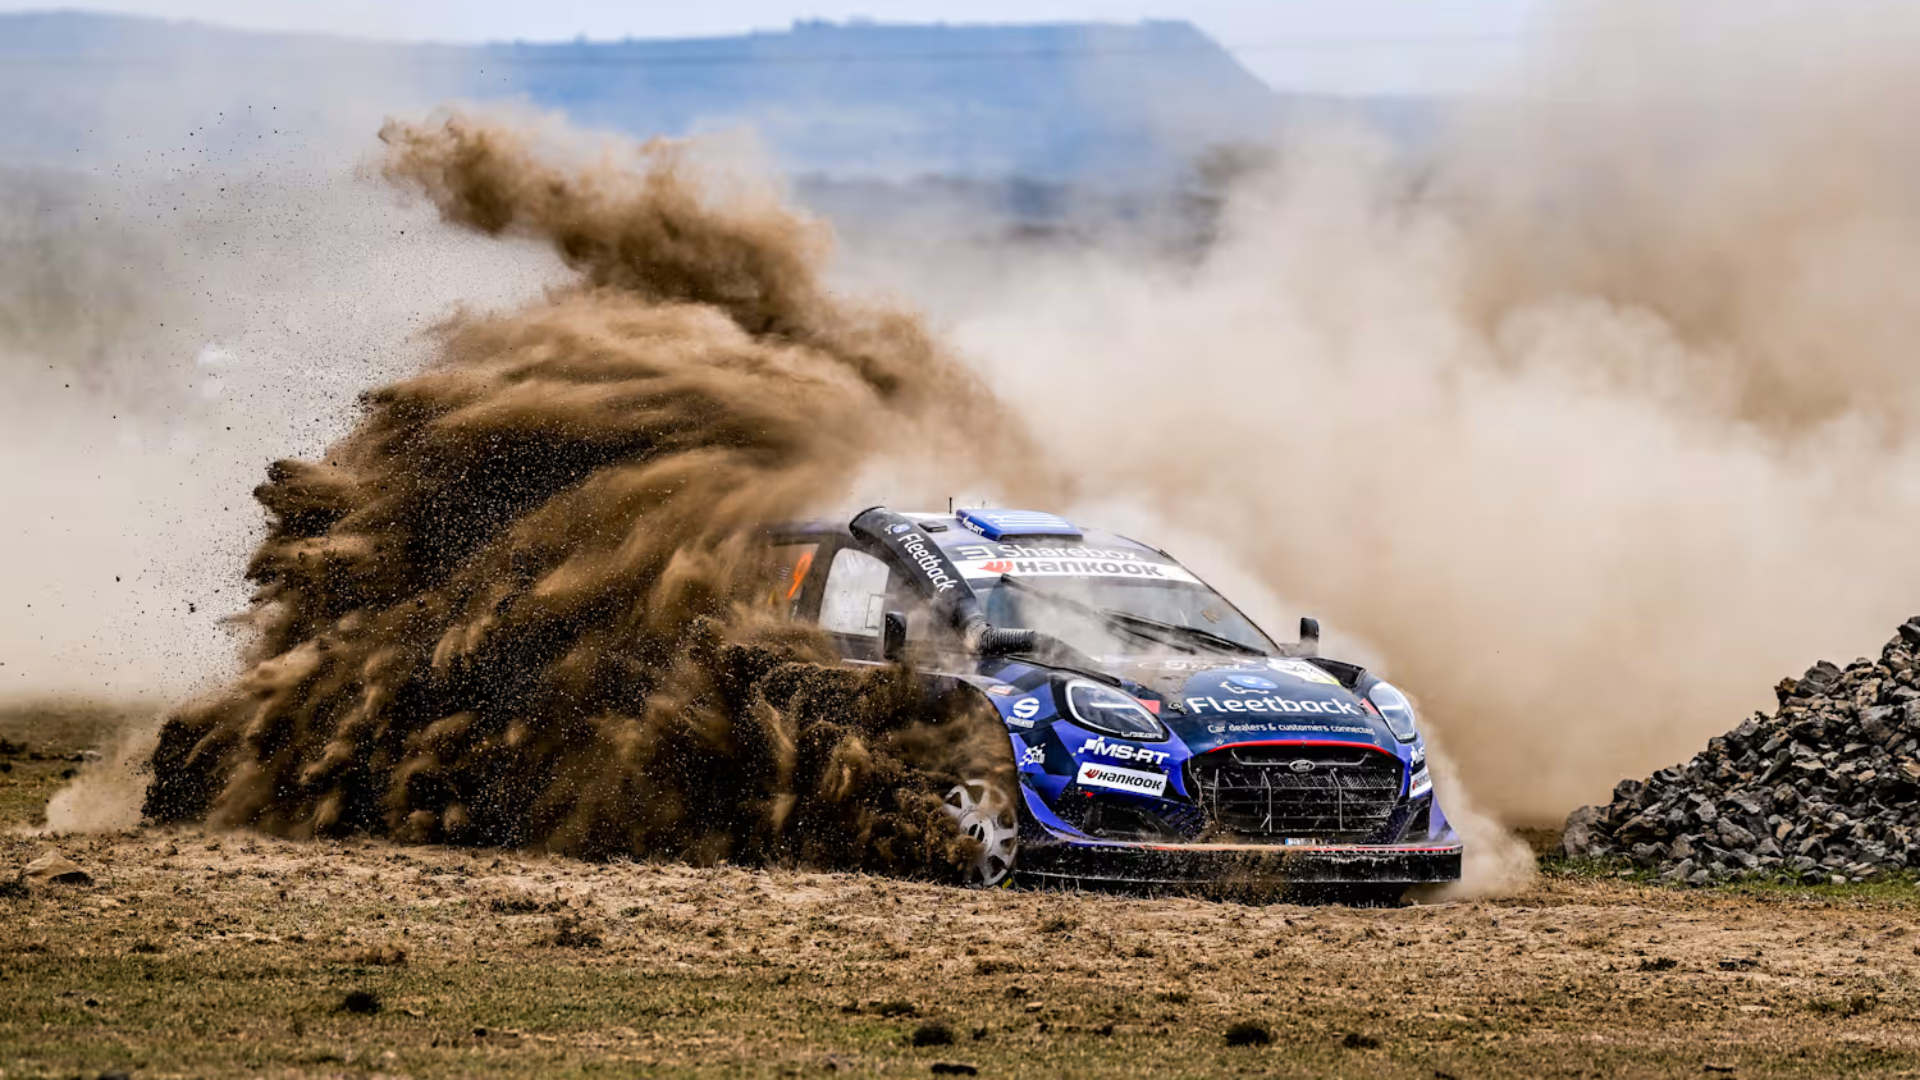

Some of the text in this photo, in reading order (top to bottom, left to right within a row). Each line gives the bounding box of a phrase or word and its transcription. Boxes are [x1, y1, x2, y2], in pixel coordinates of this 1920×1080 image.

[997, 544, 1145, 561] Sharebox
[897, 533, 958, 593] Fleetback
[1186, 696, 1362, 716] Fleetback
[1207, 722, 1376, 736] Car dealers & customers connected
[1092, 741, 1171, 766] MS-RT
